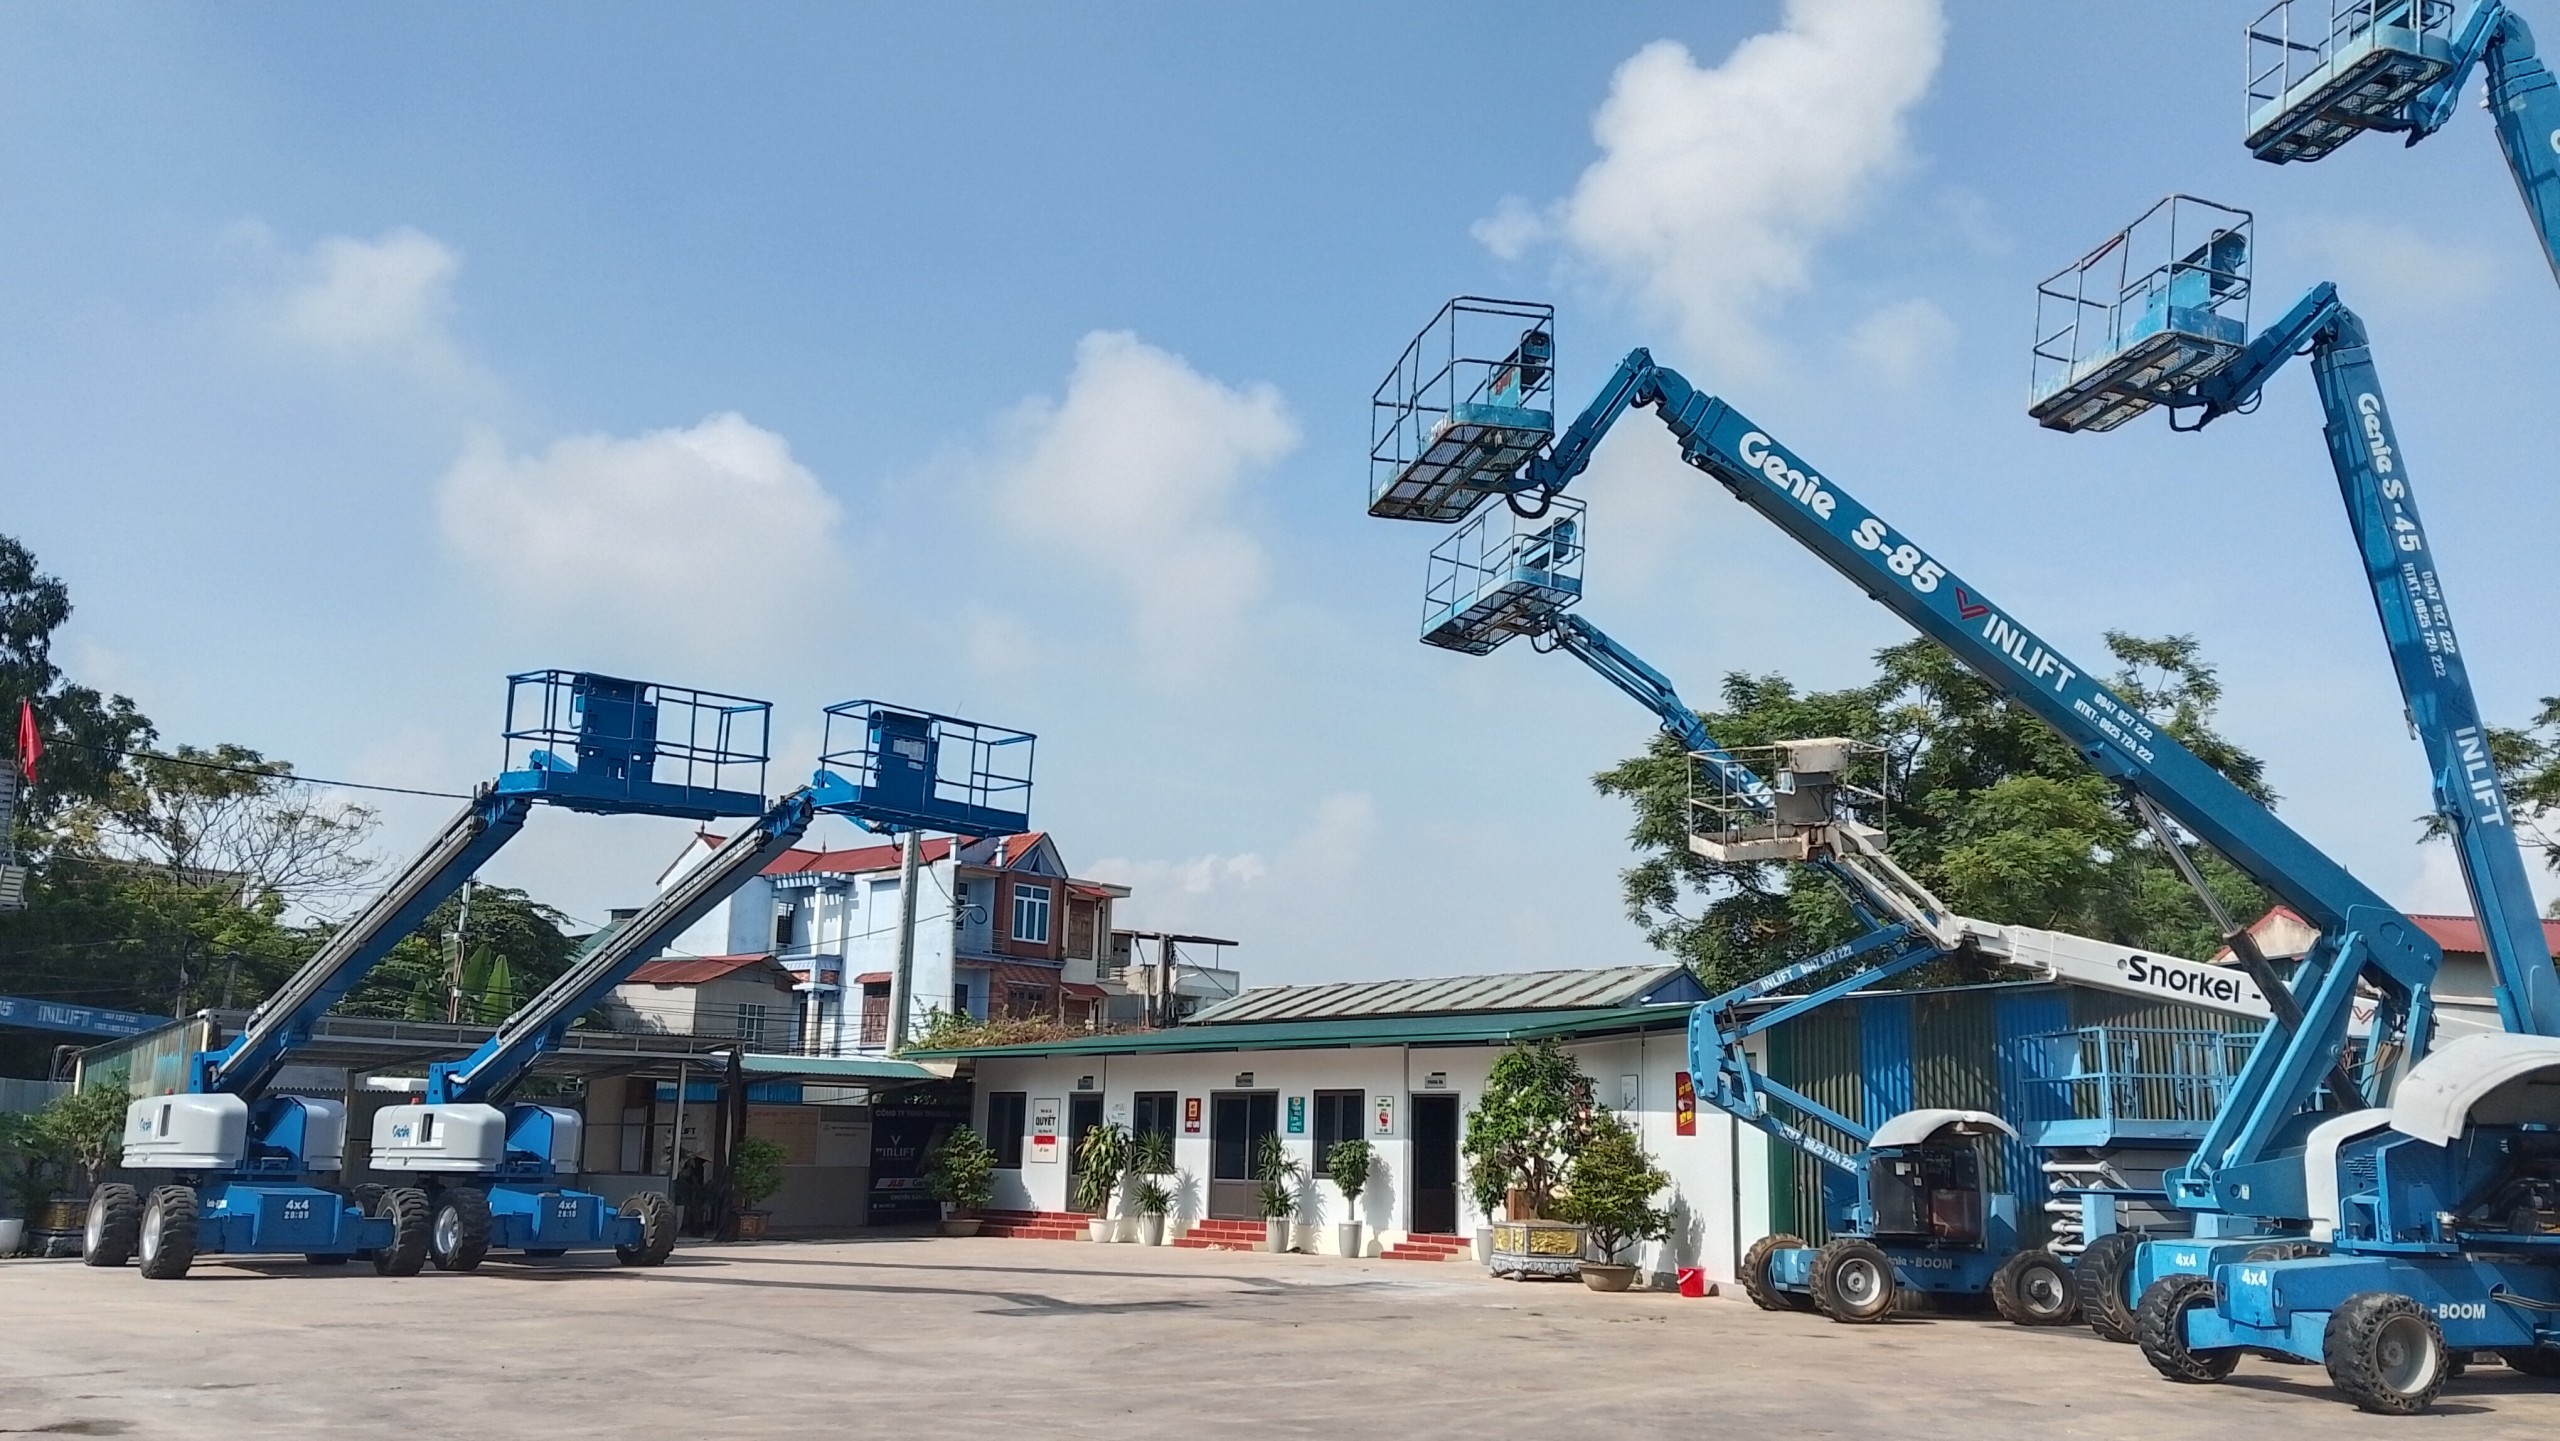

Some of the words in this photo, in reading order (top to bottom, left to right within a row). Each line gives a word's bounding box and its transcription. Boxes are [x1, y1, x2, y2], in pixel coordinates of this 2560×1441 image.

[2382, 478, 2422, 552] S-45
[1851, 518, 1946, 593] S-85
[2422, 570, 2440, 601] 0947
[2440, 630, 2456, 655] 222
[2431, 655, 2446, 678] 222
[2073, 698, 2100, 725] HTKT:
[2120, 732, 2138, 752] 724
[2136, 745, 2155, 765] 222
[2094, 692, 2118, 715] 0947
[2133, 722, 2154, 743] 222
[1800, 959, 1820, 974] 0947
[1837, 945, 1854, 960] 222
[2128, 955, 2240, 1003] Snorkel
[285, 1199, 309, 1210] 4x4
[558, 1200, 577, 1210] 4x4
[2175, 1252, 2197, 1268] 4x4
[2241, 1268, 2268, 1287] 4x4
